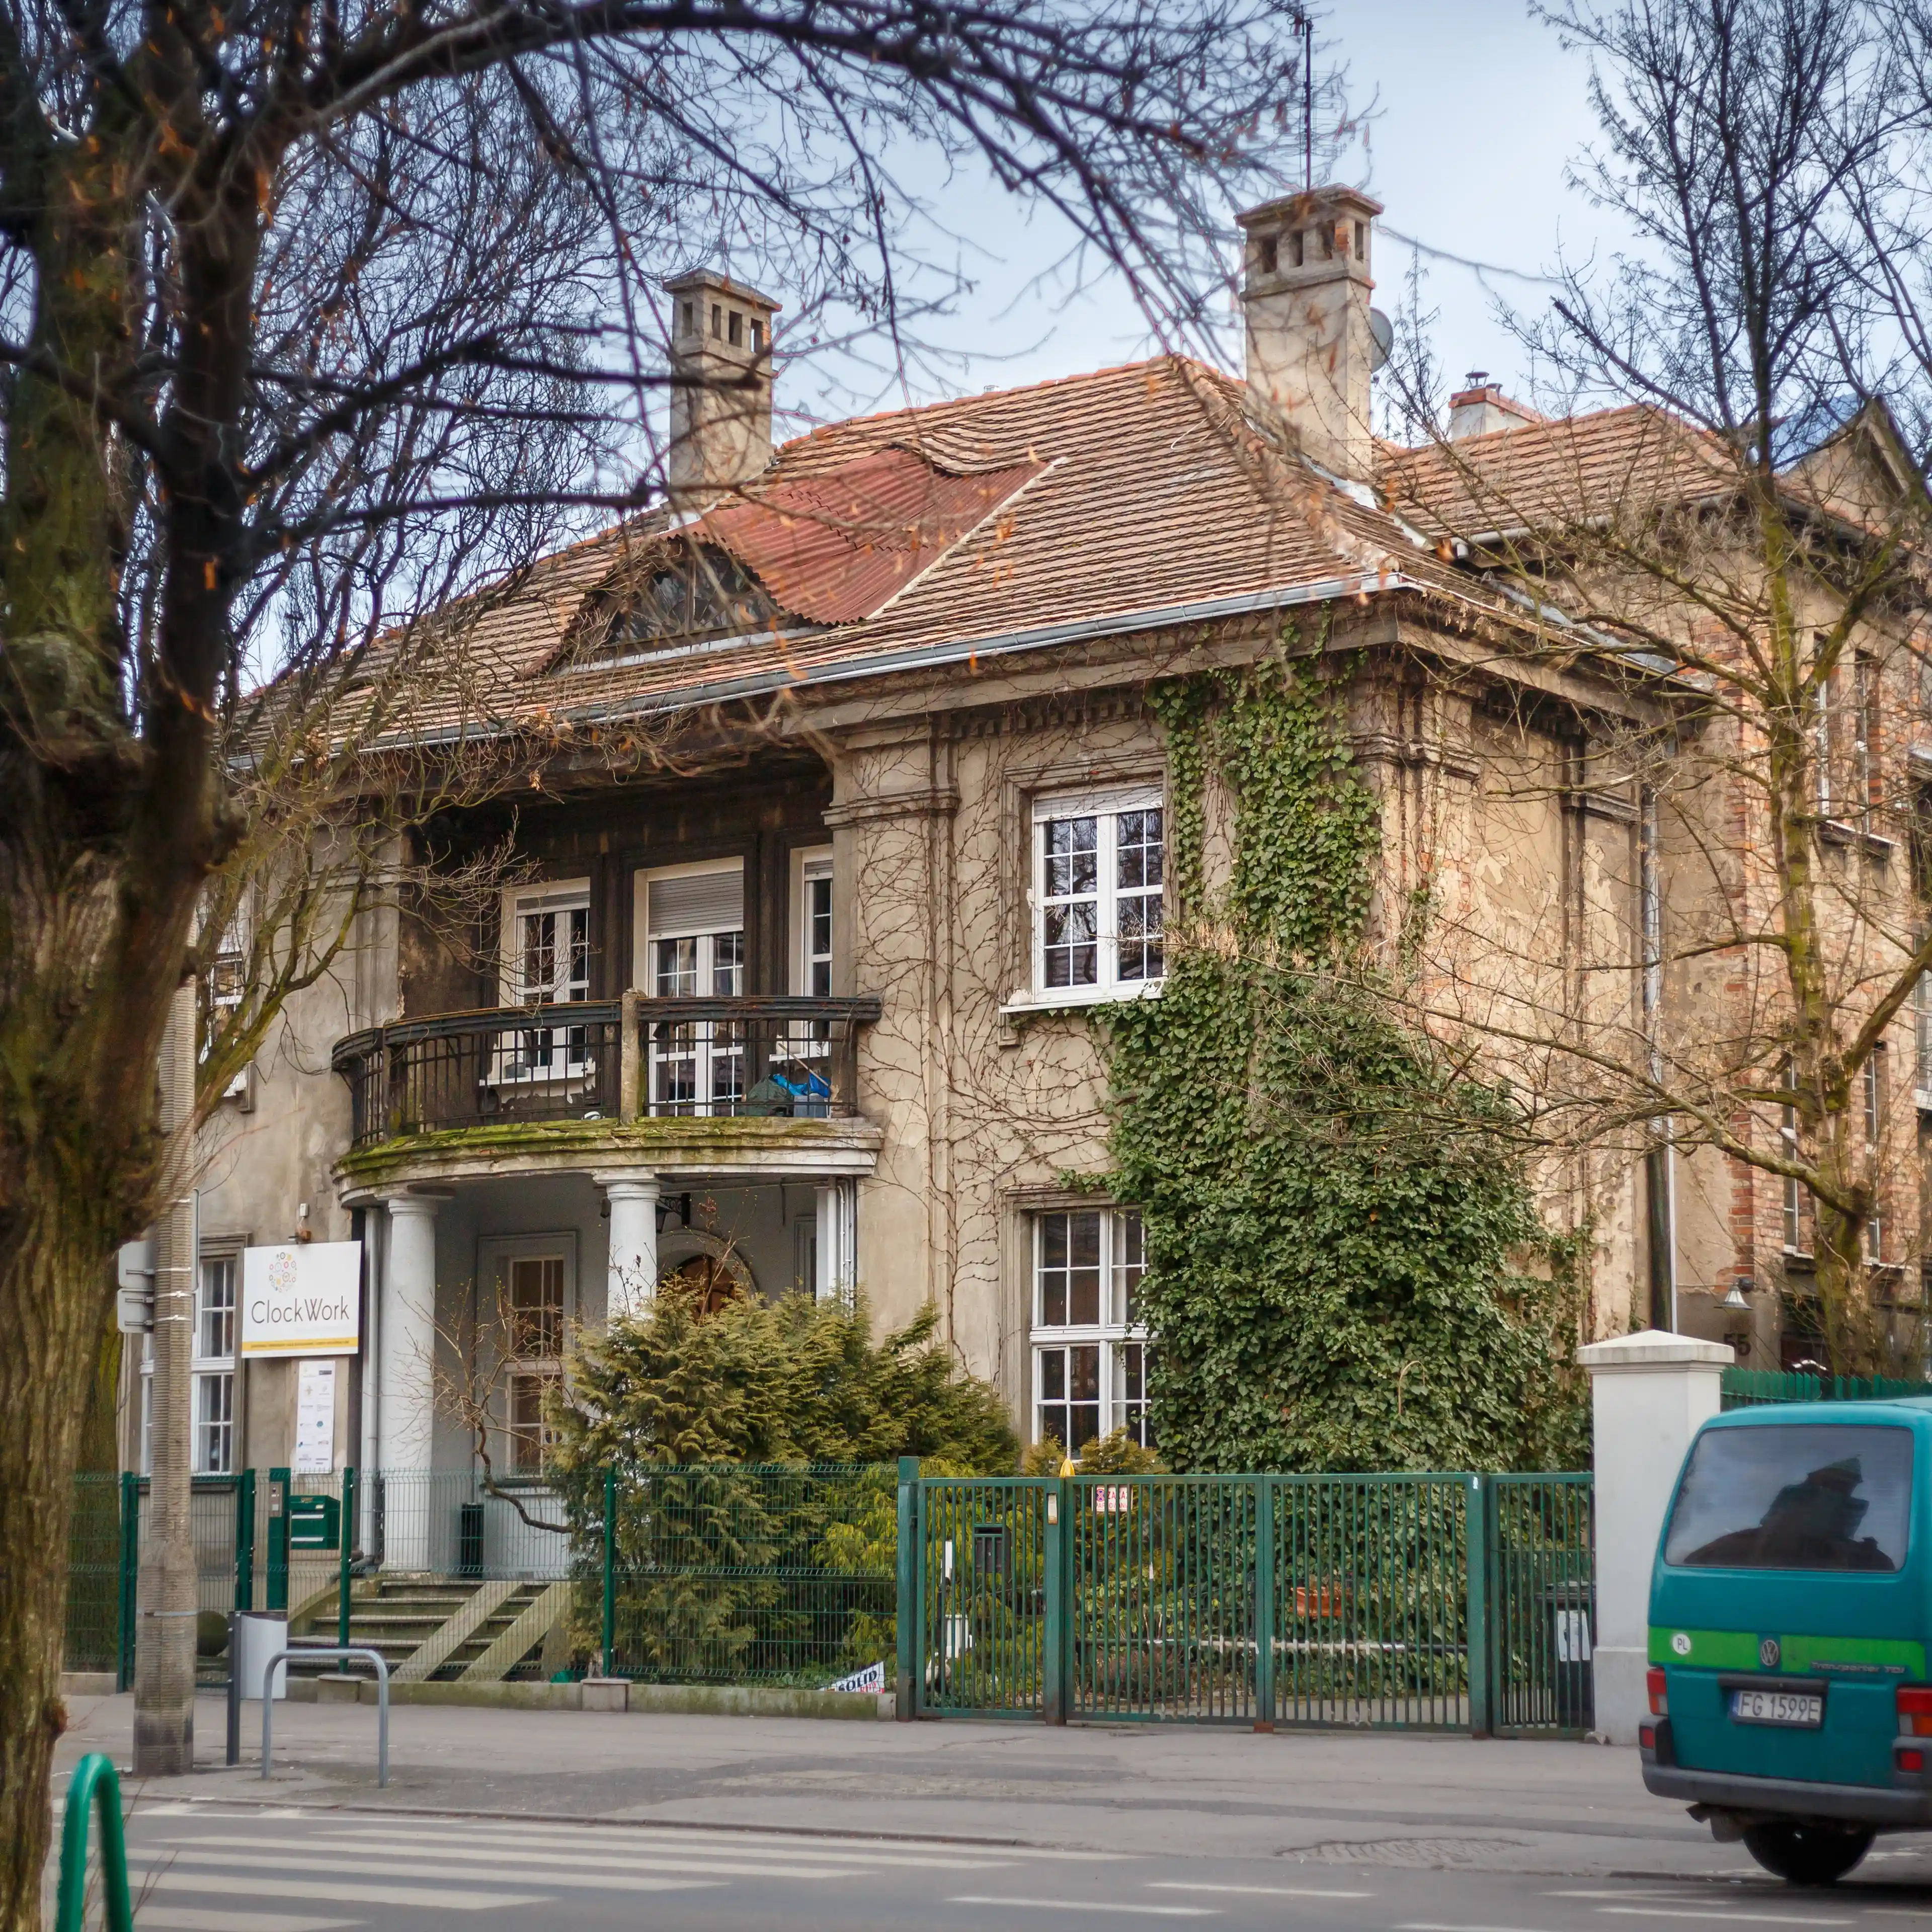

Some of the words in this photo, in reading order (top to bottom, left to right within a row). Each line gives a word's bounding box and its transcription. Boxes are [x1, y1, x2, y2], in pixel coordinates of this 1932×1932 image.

[252, 1296, 350, 1324] ClockWork
[1677, 1637, 1688, 1651] PL
[1740, 1693, 1763, 1717] FG
[1770, 1696, 1819, 1722] 1599E
